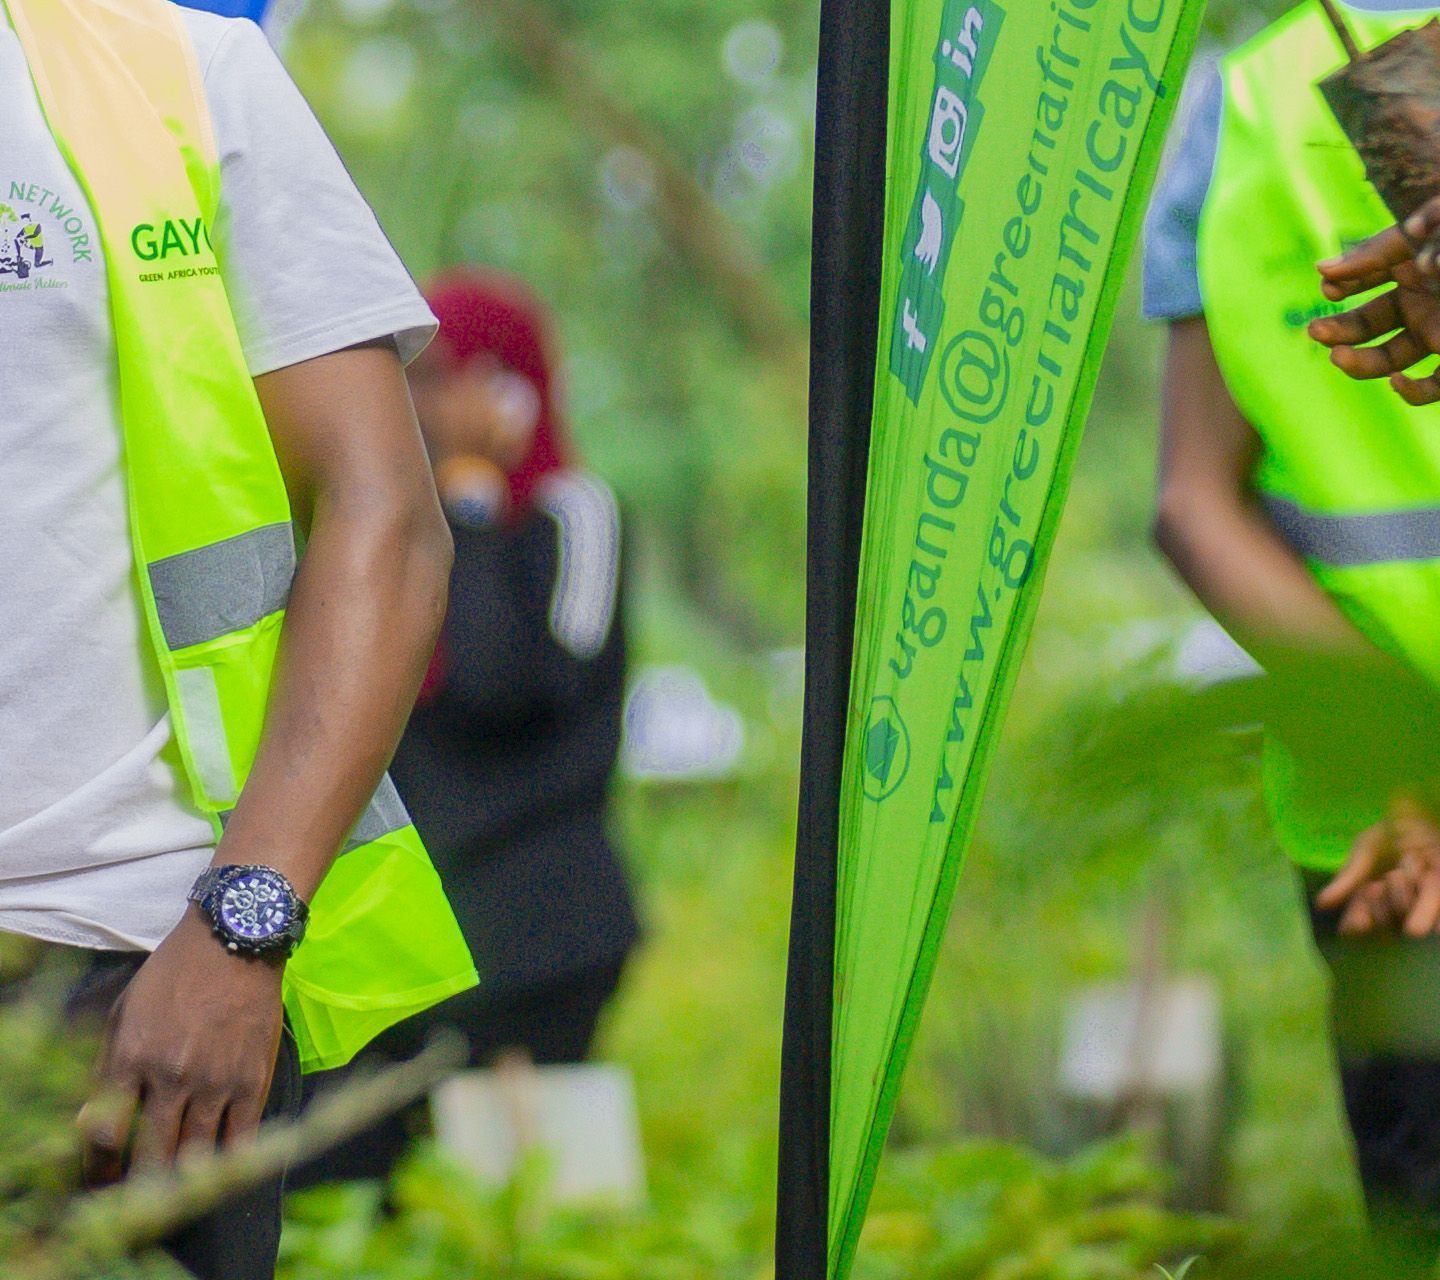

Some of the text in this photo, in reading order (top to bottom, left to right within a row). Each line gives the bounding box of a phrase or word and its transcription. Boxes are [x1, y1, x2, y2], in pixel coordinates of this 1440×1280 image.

[9, 181, 93, 263] NETWORK
[139, 272, 163, 282] GREEN
[167, 269, 197, 280] AFRICA
